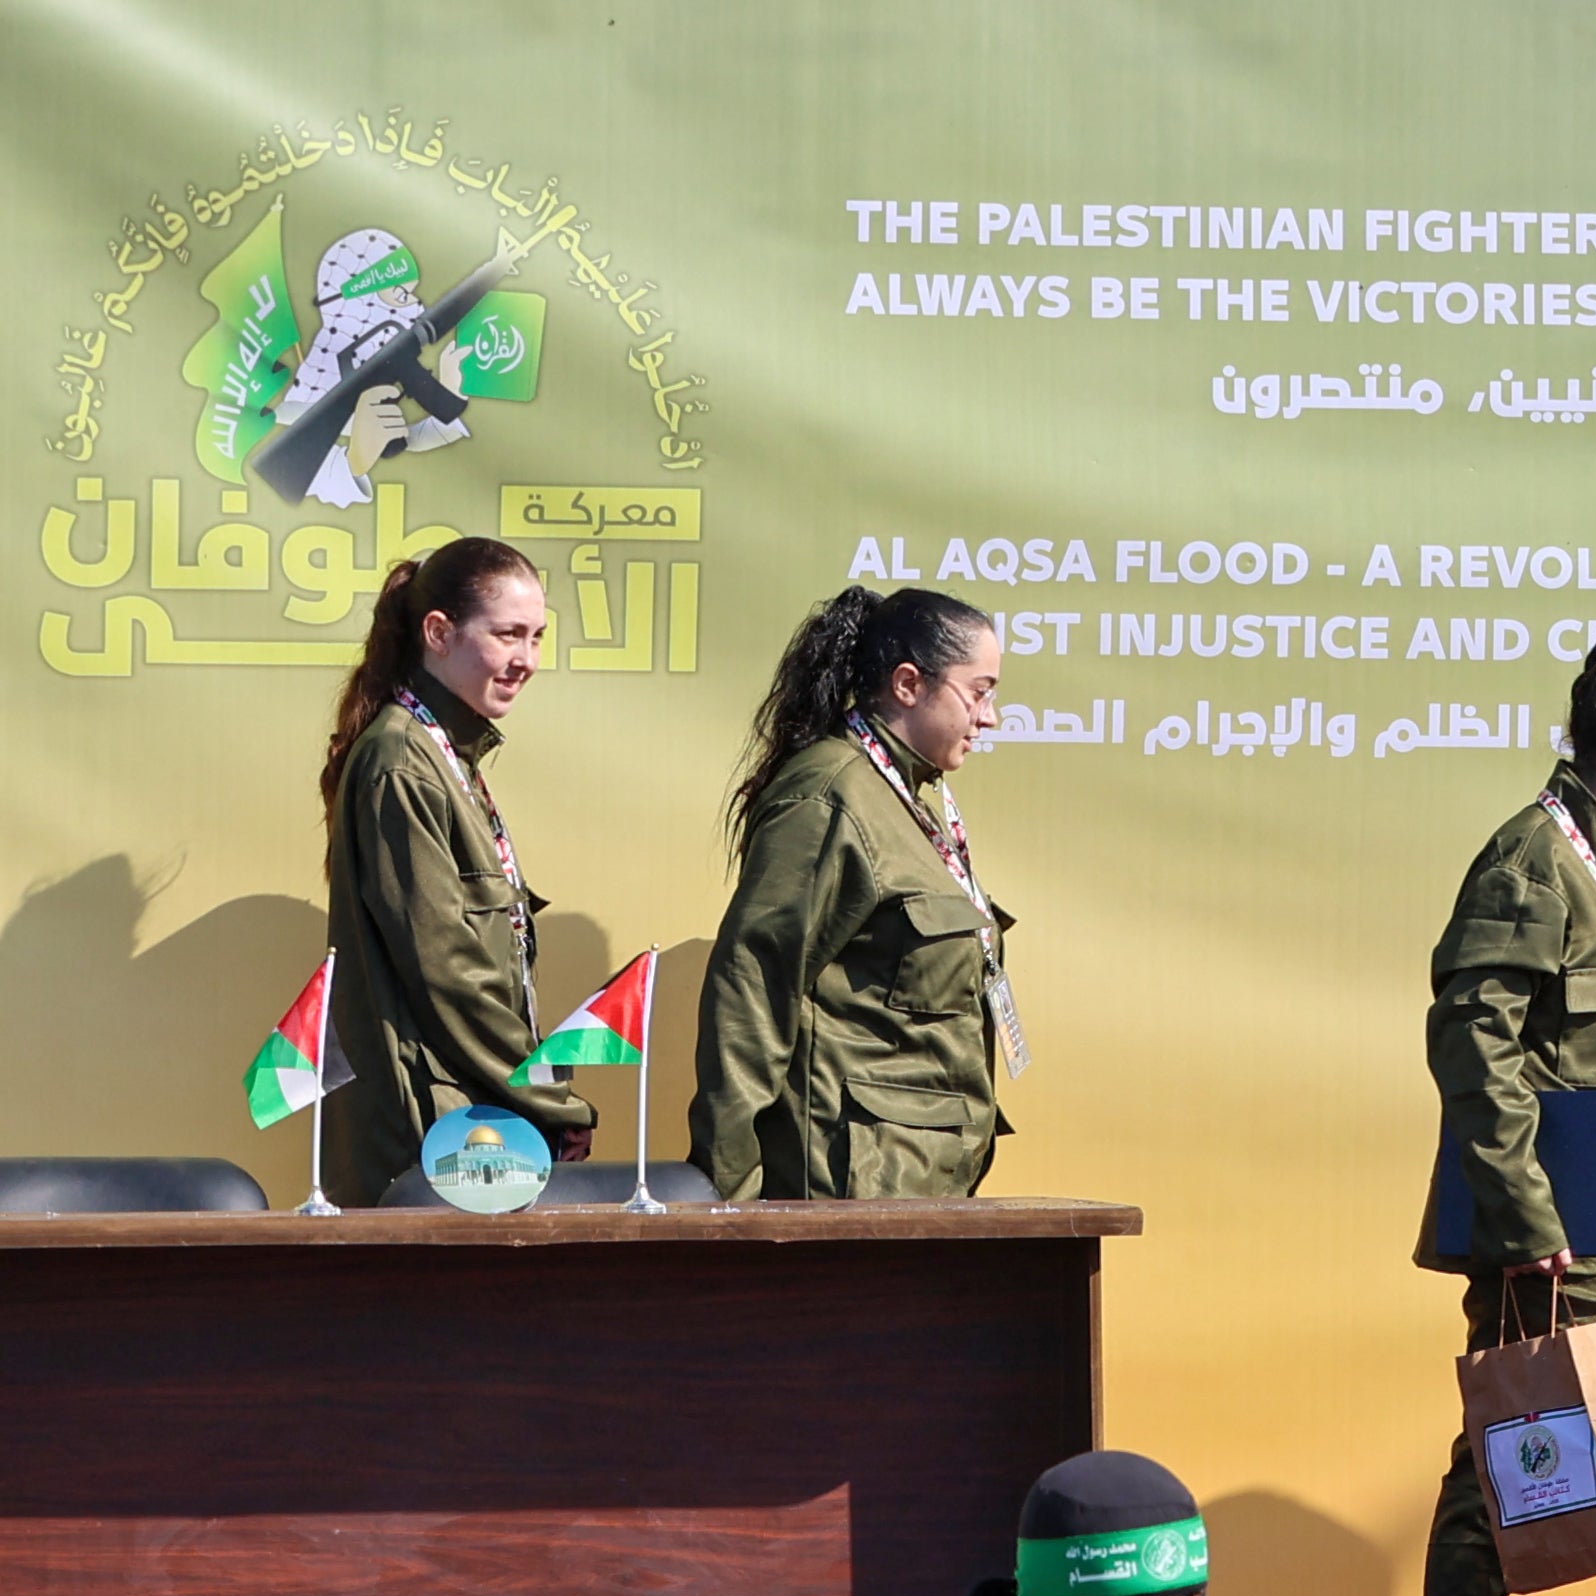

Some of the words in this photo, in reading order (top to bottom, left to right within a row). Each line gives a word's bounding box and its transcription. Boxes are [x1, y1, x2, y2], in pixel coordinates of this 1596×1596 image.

[846, 200, 959, 244] THE
[979, 203, 1345, 250] PALESTINIAN
[846, 272, 1071, 318] ALWAYS
[1091, 276, 1161, 320] BE
[1176, 277, 1290, 322] THE
[1212, 363, 1445, 419] منتصرون
[523, 493, 677, 536] معركة
[848, 536, 921, 580] AL
[937, 538, 1097, 586] AQSA
[1115, 540, 1309, 585] FLOOD
[1362, 544, 1401, 586] A
[993, 611, 1081, 655] IST
[1100, 613, 1389, 659] INJUSTICE
[1407, 617, 1530, 660] AND
[1144, 698, 1356, 757] والإجرام
[1374, 702, 1530, 757] الظلم
[1068, 1559, 1138, 1588] القسام
